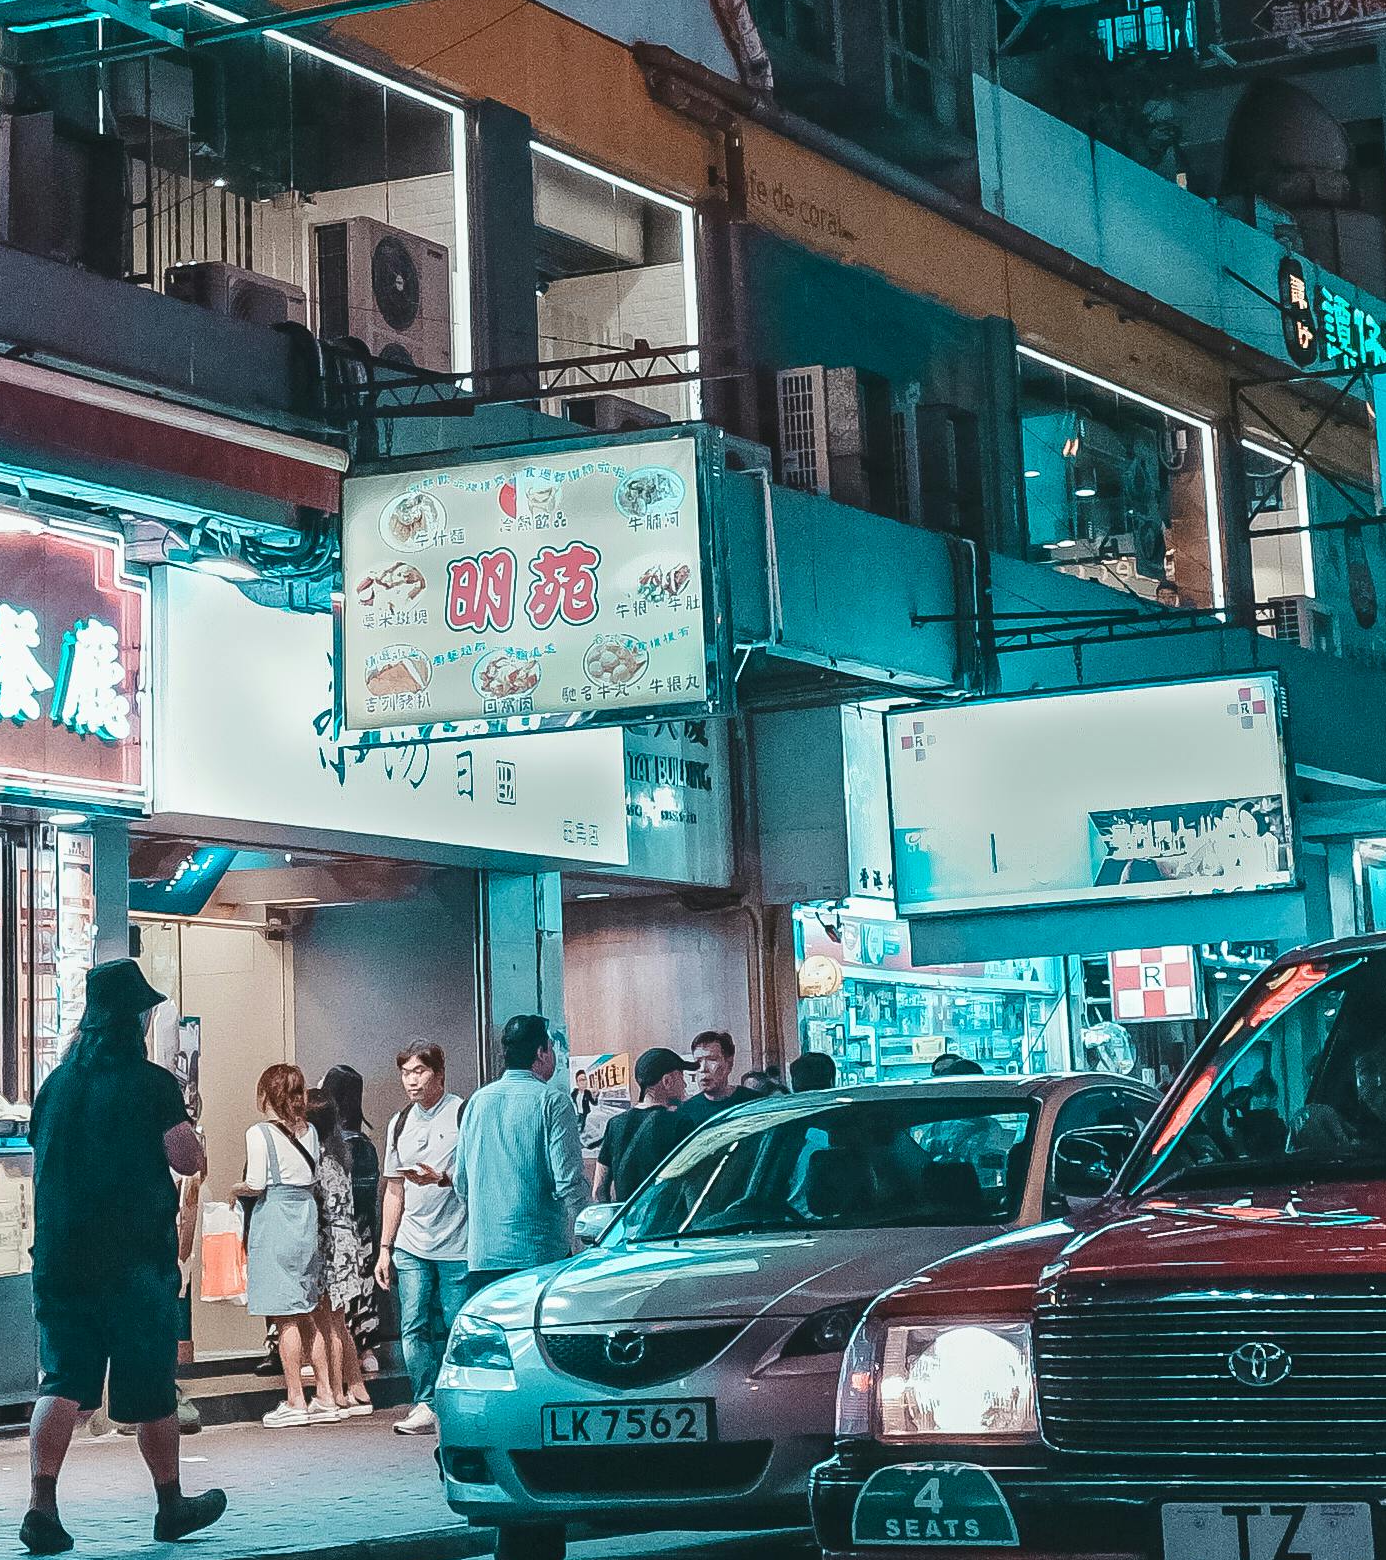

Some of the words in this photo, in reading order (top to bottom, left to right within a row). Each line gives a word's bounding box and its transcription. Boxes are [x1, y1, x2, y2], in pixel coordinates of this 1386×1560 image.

[445, 540, 600, 634] 明苑
[1144, 966, 1161, 987] R
[550, 1410, 592, 1443] LK
[600, 1406, 699, 1441] 7562
[914, 1478, 943, 1514] 4
[886, 1519, 980, 1537] SEATS
